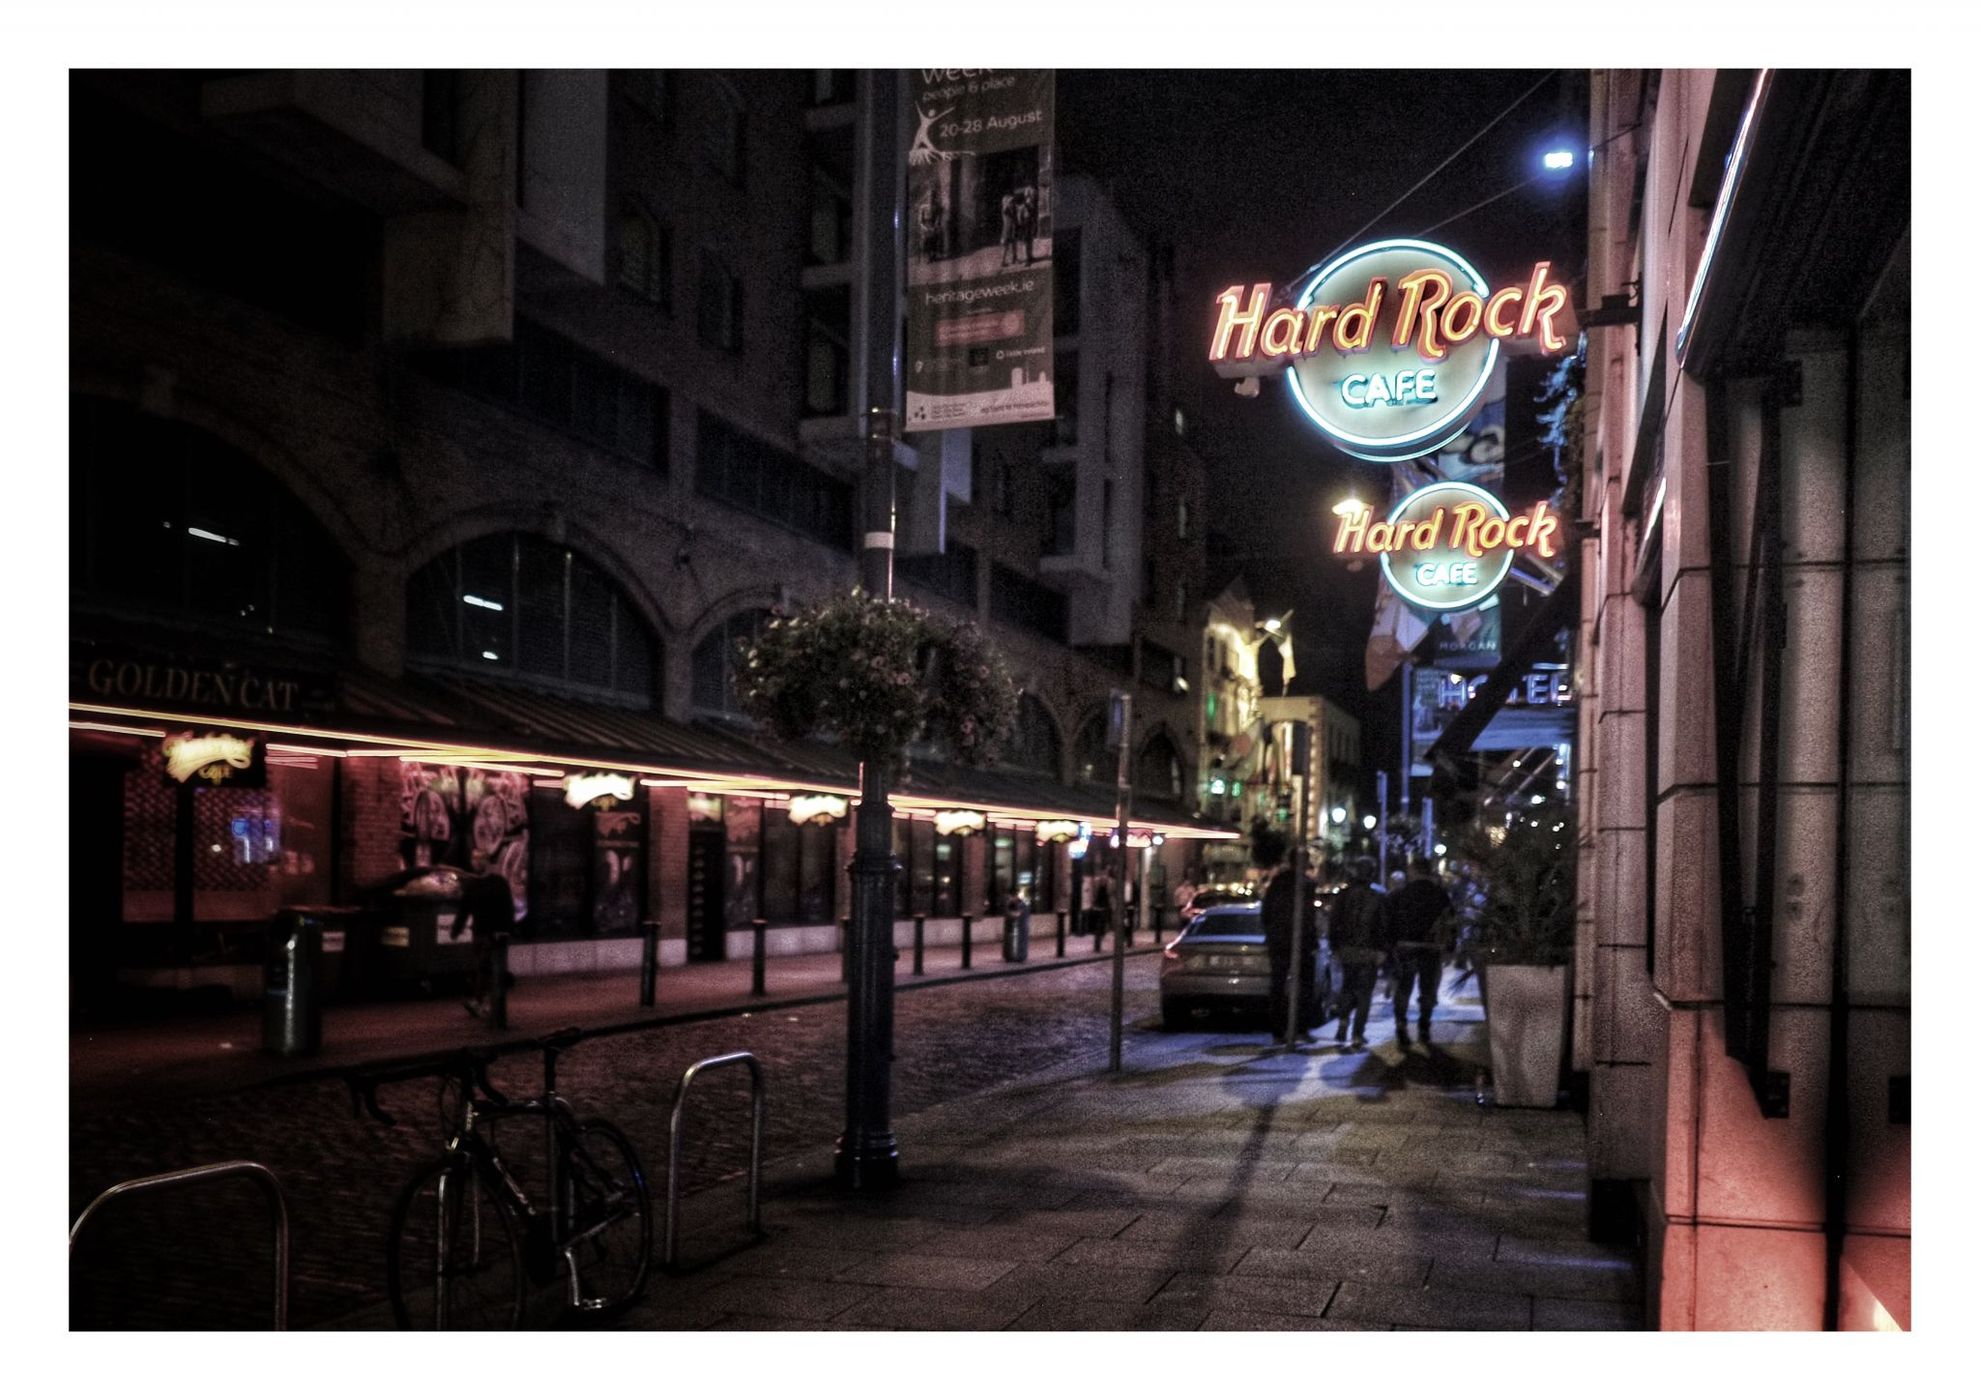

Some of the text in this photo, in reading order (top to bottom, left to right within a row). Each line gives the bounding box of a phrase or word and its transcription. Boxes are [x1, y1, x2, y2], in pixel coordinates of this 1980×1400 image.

[981, 76, 1016, 91] place
[939, 109, 1044, 138] 20-28 August
[925, 280, 1034, 306] heritageweek.ie
[1209, 261, 1567, 361] Hard Rock
[1340, 368, 1440, 408] CAFE
[1331, 500, 1562, 558] Hard Rock
[1414, 561, 1480, 587] CAFE
[1439, 640, 1497, 651] MORGAN
[88, 658, 299, 711] GOLDEN CAT
